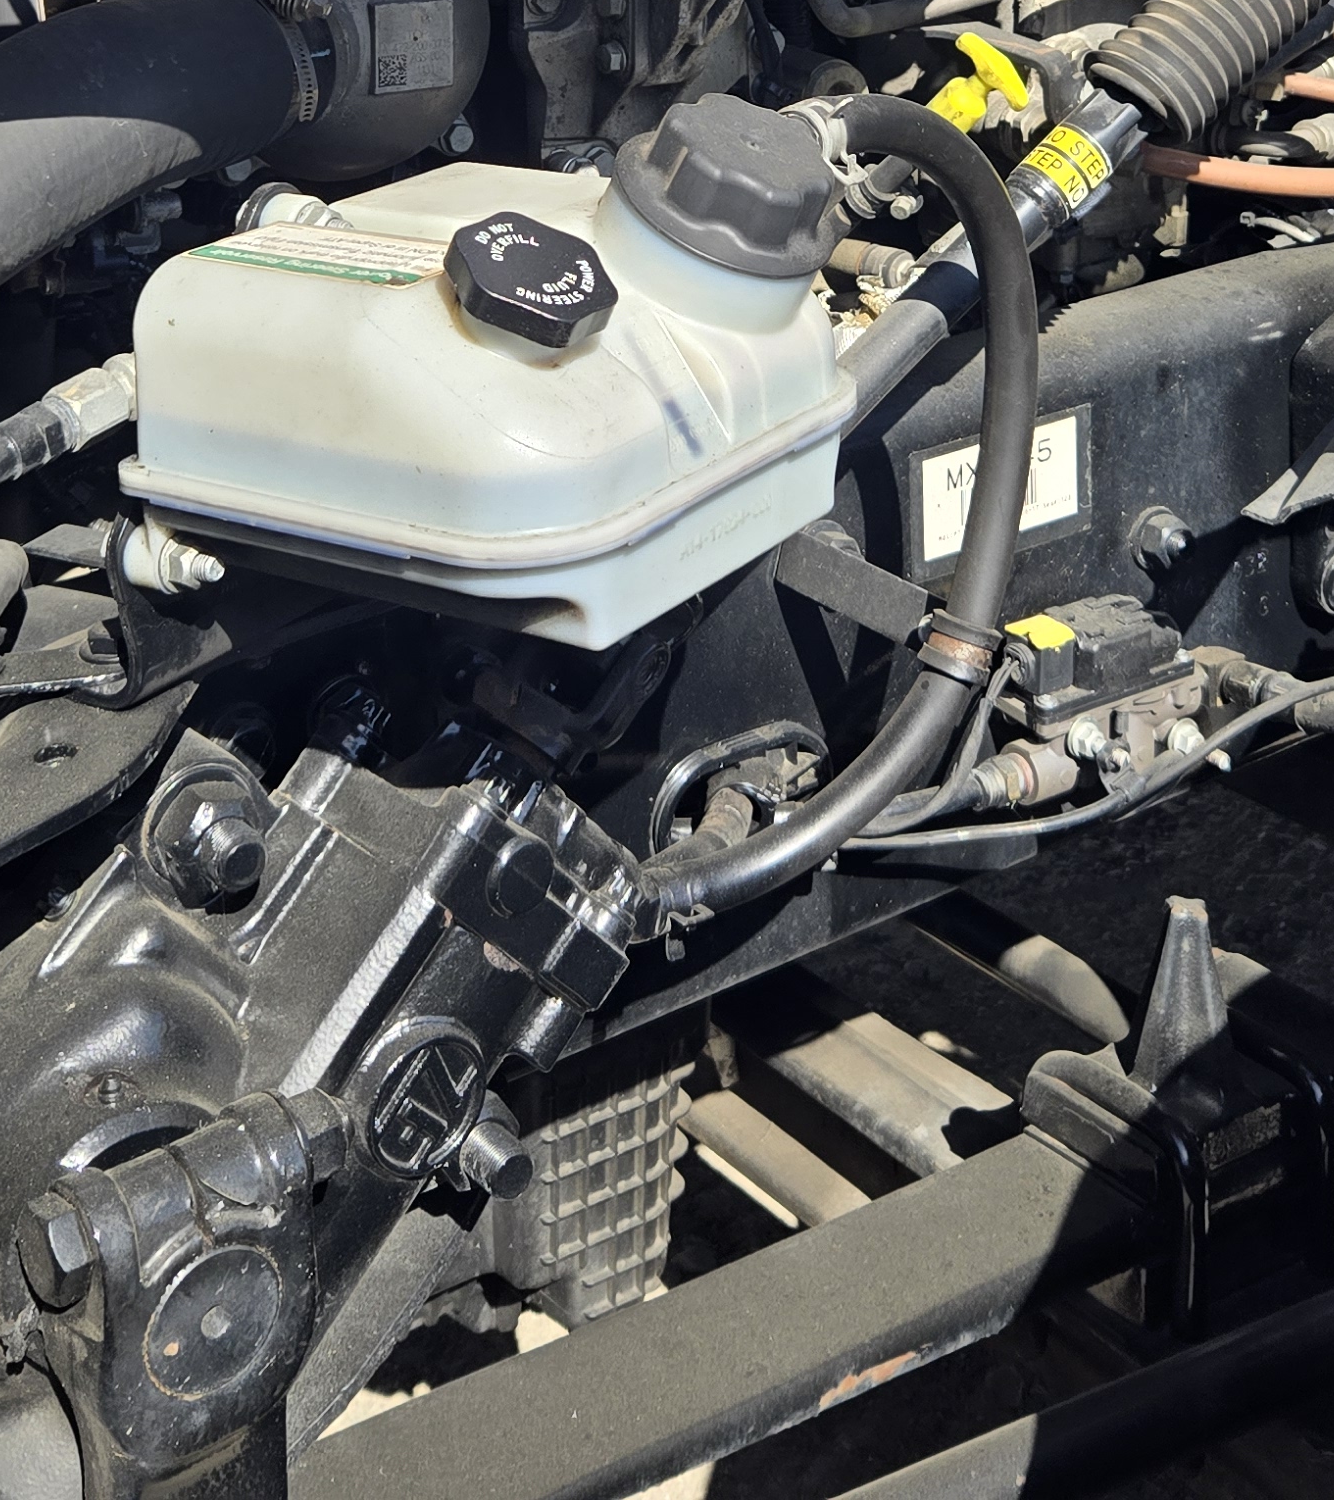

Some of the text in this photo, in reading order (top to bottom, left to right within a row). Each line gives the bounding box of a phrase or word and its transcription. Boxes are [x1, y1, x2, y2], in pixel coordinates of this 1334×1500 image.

[1069, 140, 1105, 180] STEP
[1025, 149, 1085, 203] TEP NO
[475, 222, 514, 245] DO NOT
[490, 233, 540, 262] OVERFILL
[282, 256, 350, 274] Steering
[515, 259, 595, 306] POWER STEERING
[542, 271, 577, 293] FLUID
